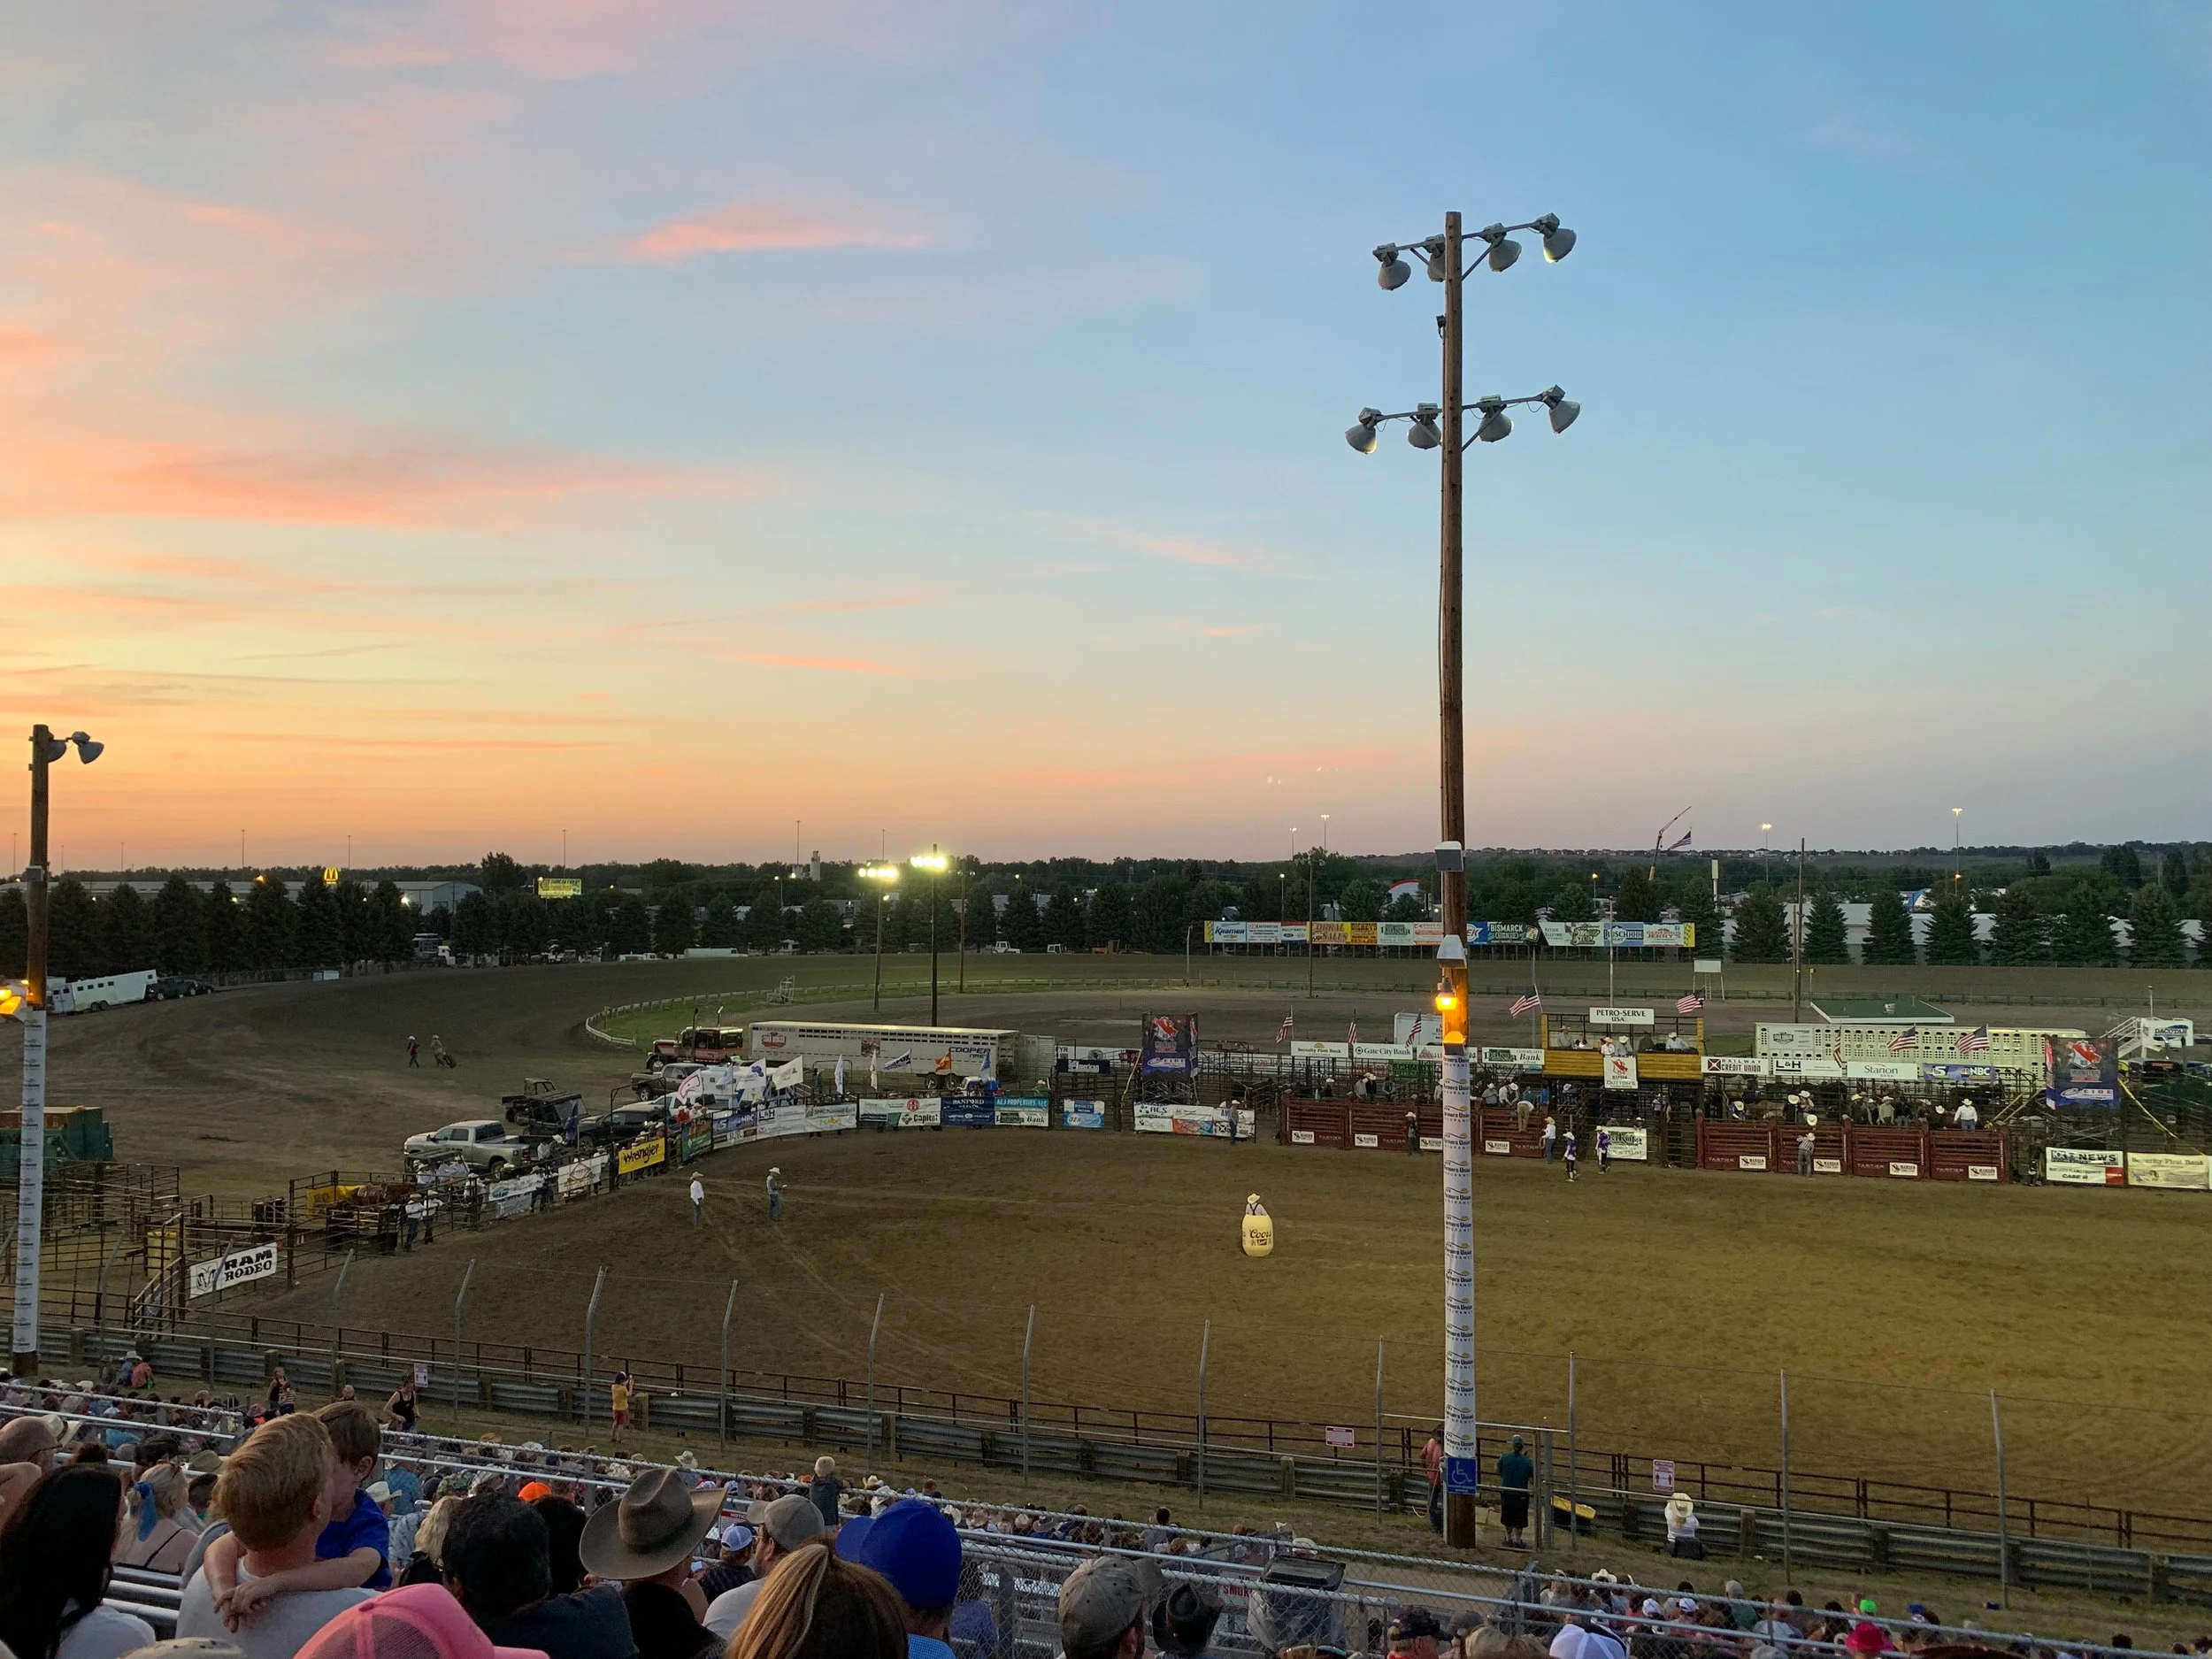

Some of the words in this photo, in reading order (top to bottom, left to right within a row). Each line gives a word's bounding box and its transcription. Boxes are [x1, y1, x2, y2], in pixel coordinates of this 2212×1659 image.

[1490, 924, 1523, 933] BISMARCK
[1380, 1047, 1393, 1056] City
[1970, 1067, 1990, 1076] NBC
[623, 1143, 660, 1164] Wrangler
[2078, 1153, 2116, 1162] NEWS
[224, 1249, 273, 1271] RAM
[225, 1260, 273, 1282] RODEO
